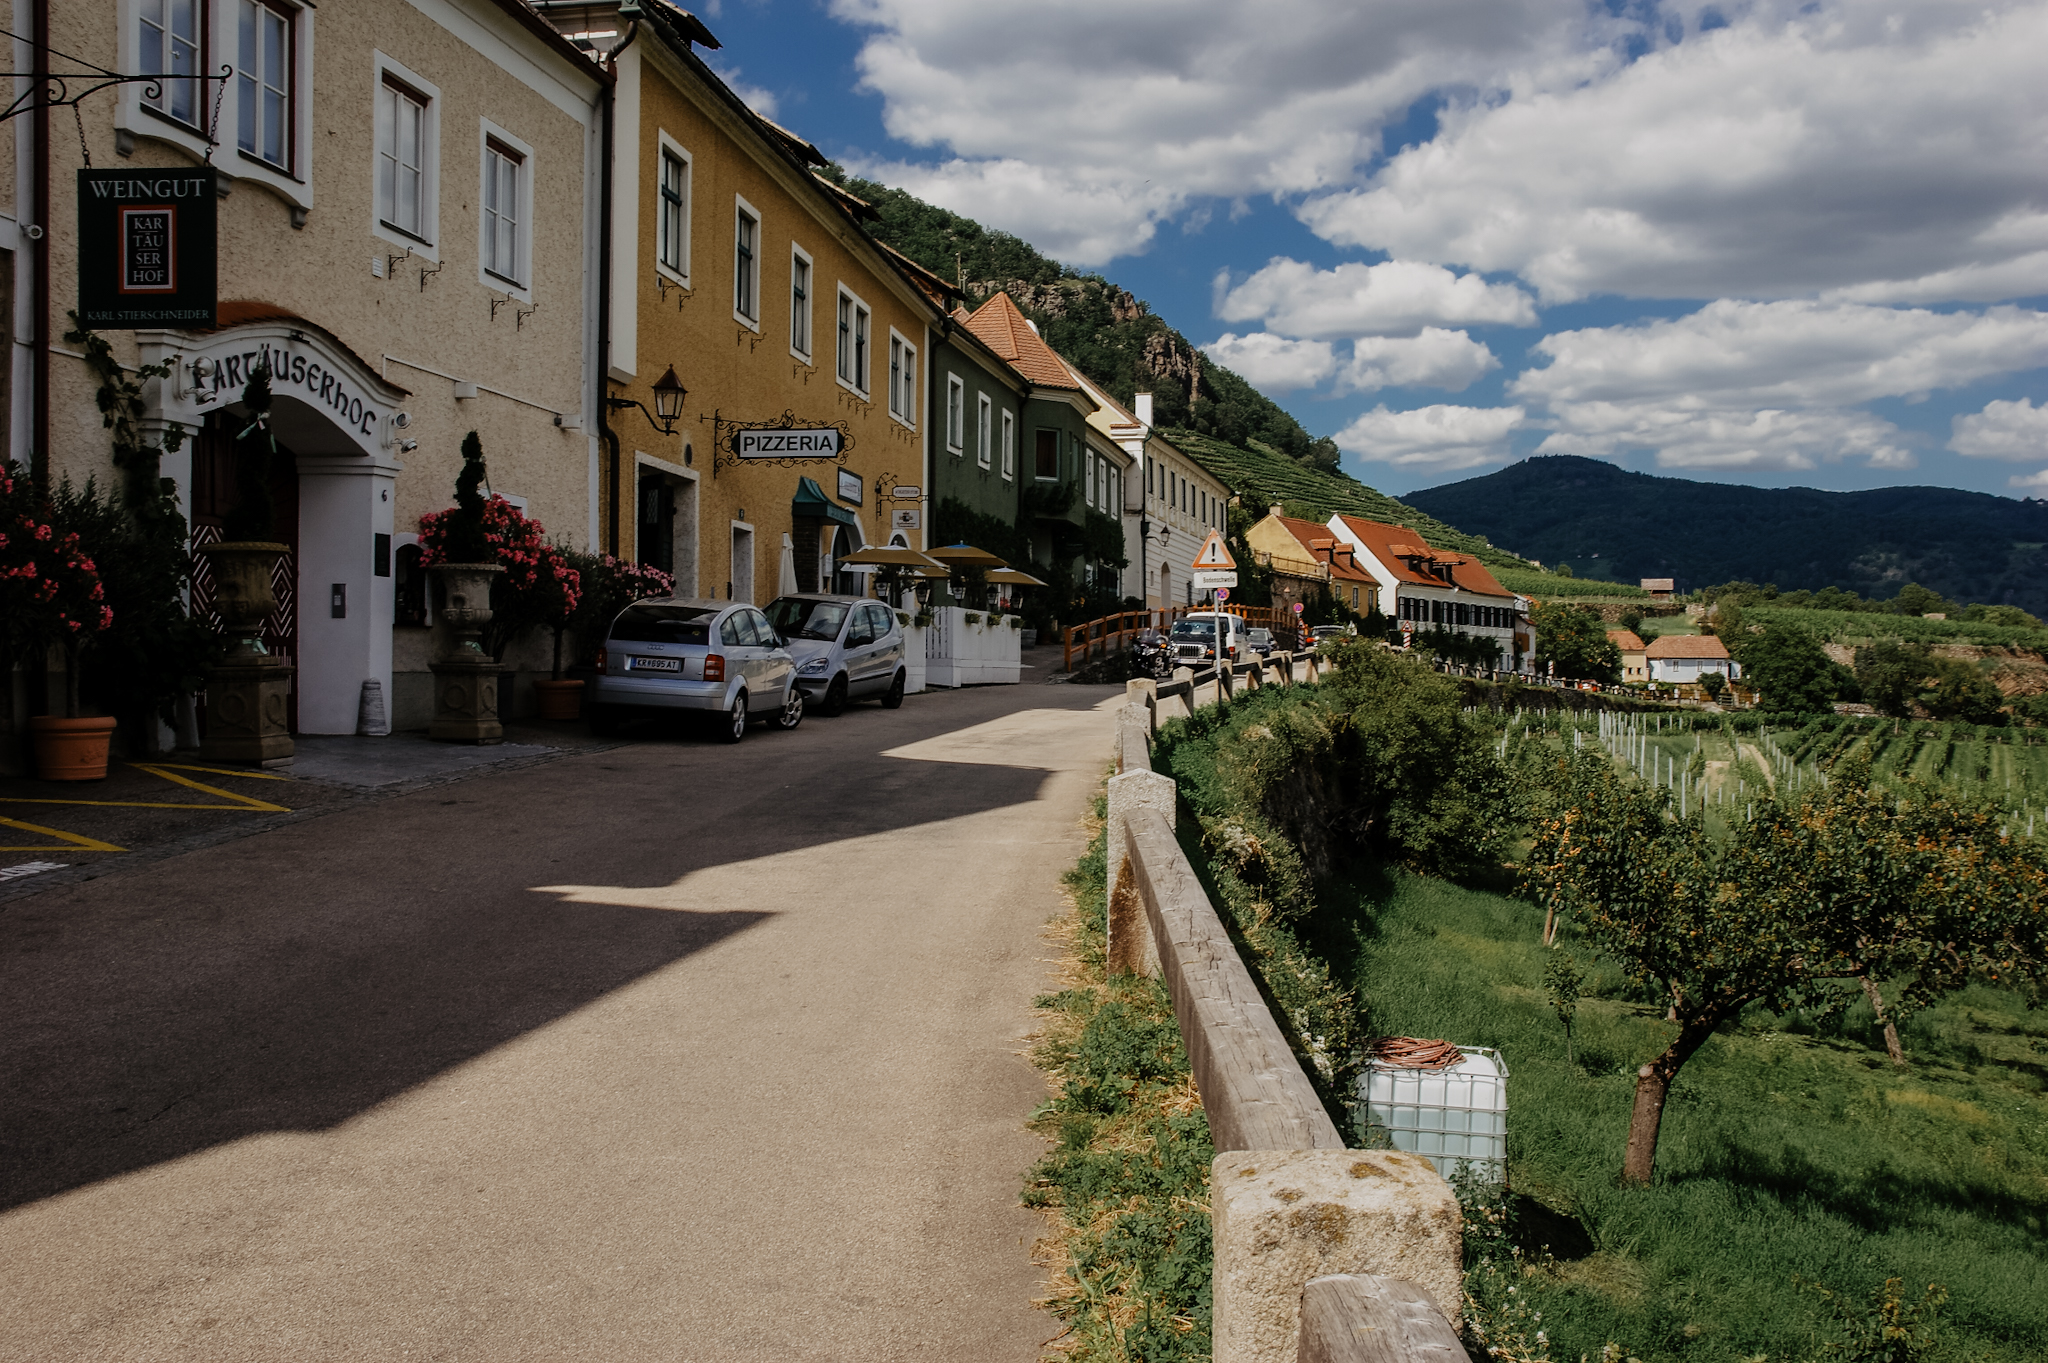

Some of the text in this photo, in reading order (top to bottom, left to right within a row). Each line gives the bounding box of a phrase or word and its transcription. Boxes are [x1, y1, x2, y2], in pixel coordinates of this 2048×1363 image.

[89, 178, 206, 198] WEINGUT
[134, 217, 163, 230] KAR
[132, 233, 164, 247] TÄU
[135, 253, 161, 265] SER
[133, 270, 165, 282] HOF
[87, 309, 209, 321] KARL STIERSCHNEIDER
[743, 435, 833, 451] PIZZERIA
